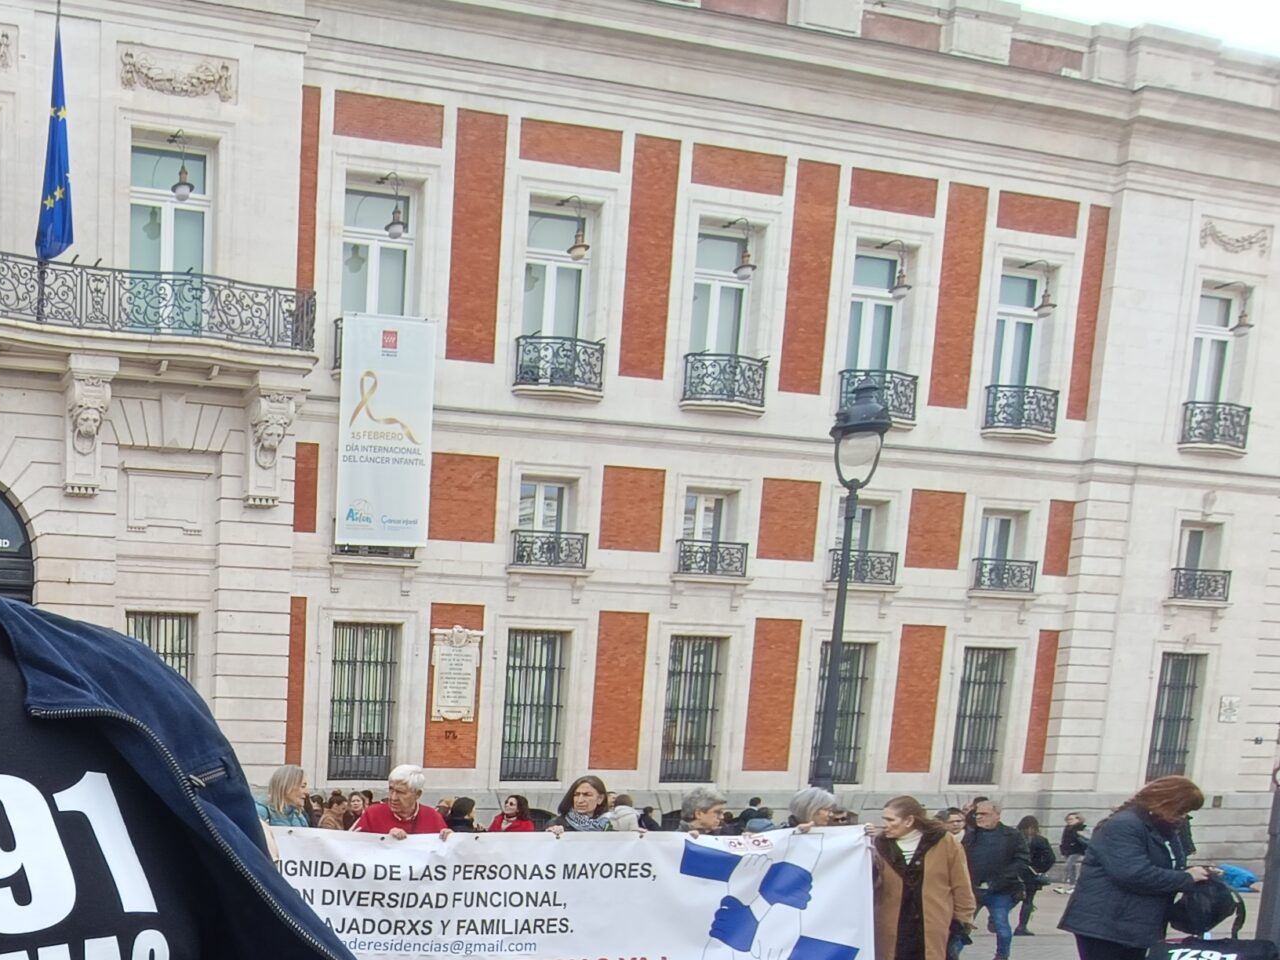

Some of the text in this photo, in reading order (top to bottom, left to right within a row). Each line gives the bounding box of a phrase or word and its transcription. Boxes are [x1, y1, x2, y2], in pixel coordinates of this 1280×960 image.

[351, 431, 404, 441] 15 FEBRERO
[345, 443, 422, 456] DÍA INTERNACIONAL
[342, 455, 358, 463] DEL
[392, 457, 426, 467] INFANTIL
[273, 860, 657, 882] IGNIDAD DE LAS PERSONAS MAYORES,
[321, 888, 449, 909] DIVERSIDAD
[452, 891, 568, 909] FUNCIONAL,
[440, 919, 451, 936] Y
[456, 917, 574, 936] FAMILIARES.
